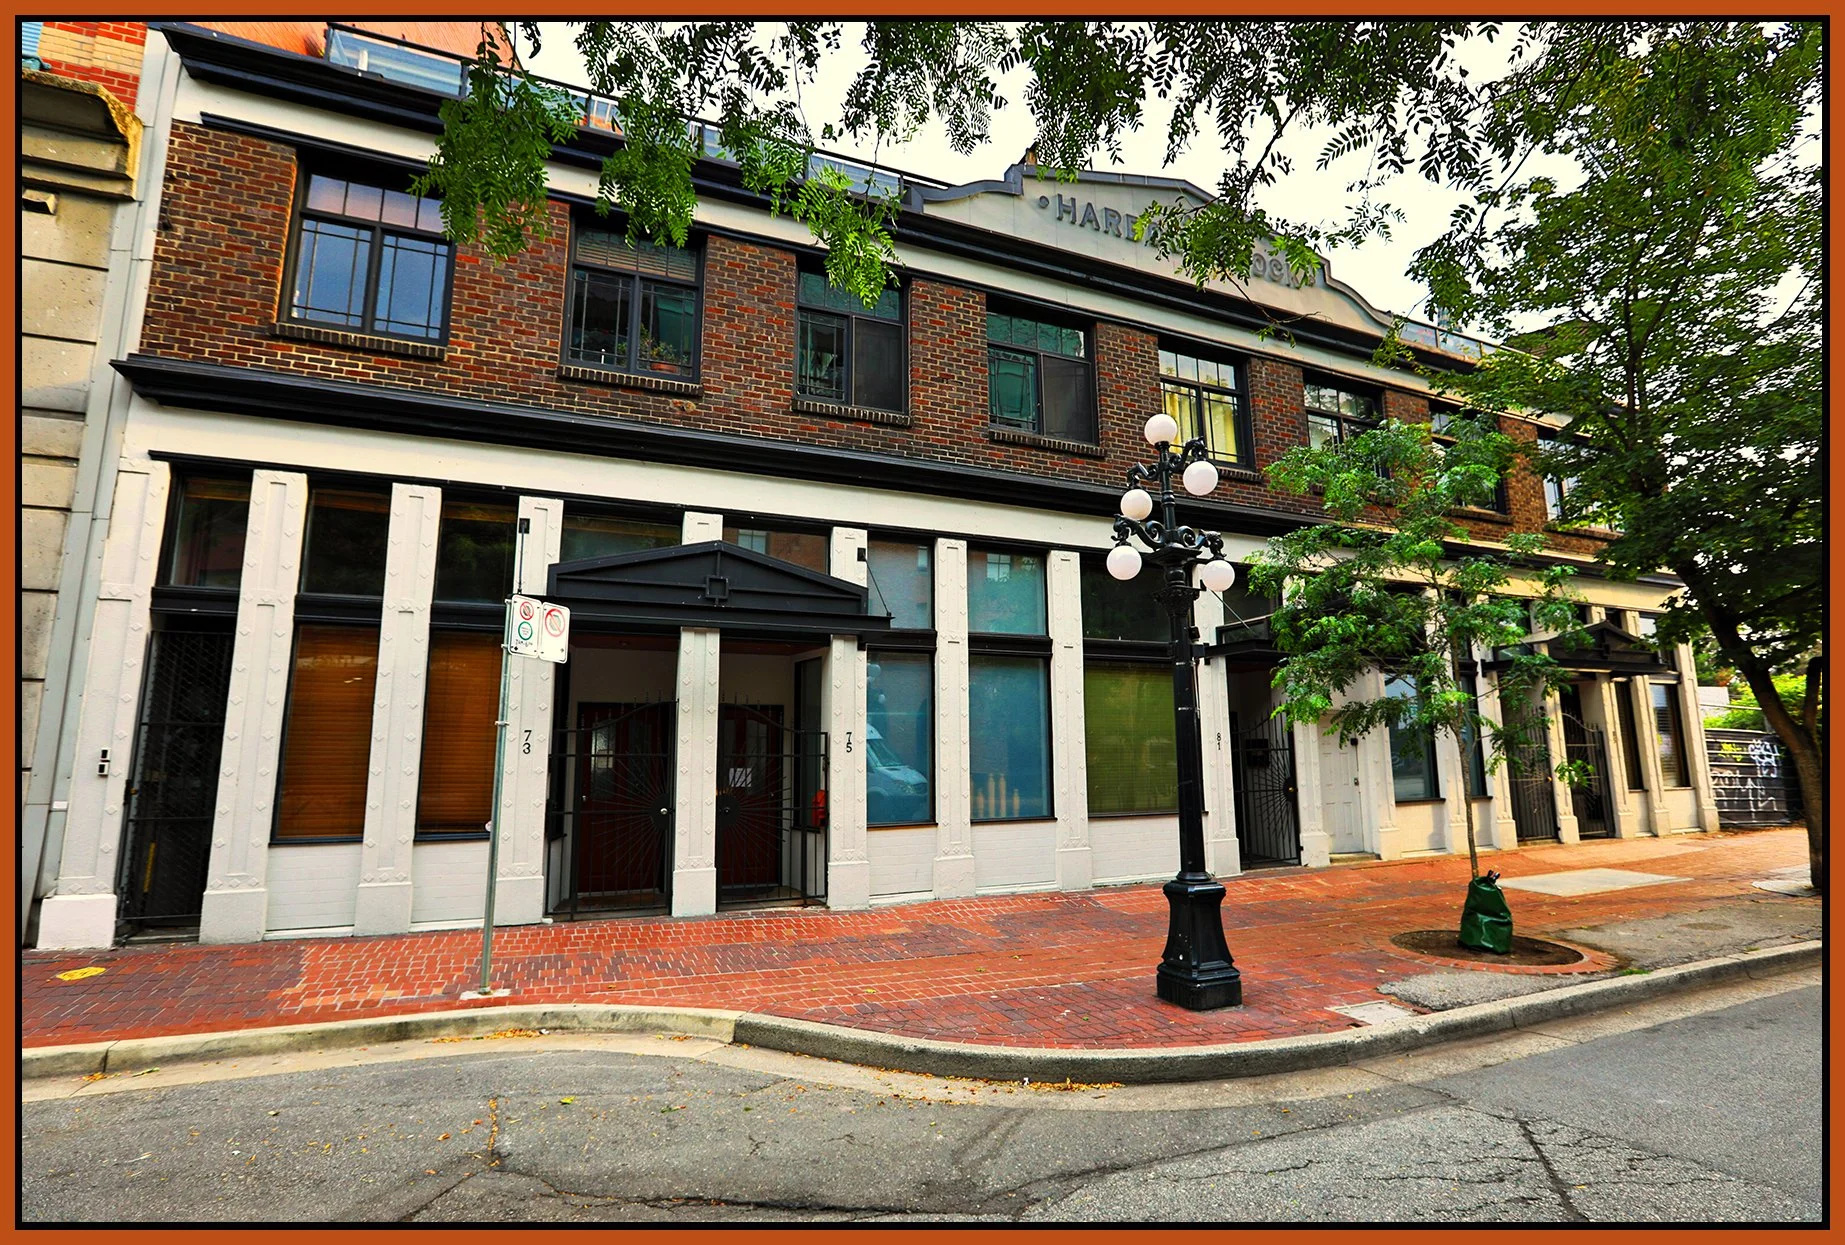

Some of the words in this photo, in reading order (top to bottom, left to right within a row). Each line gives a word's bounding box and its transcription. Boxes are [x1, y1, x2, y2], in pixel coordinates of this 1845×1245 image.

[523, 729, 532, 755] 73
[845, 731, 853, 753] 75
[1216, 732, 1222, 751] 81
